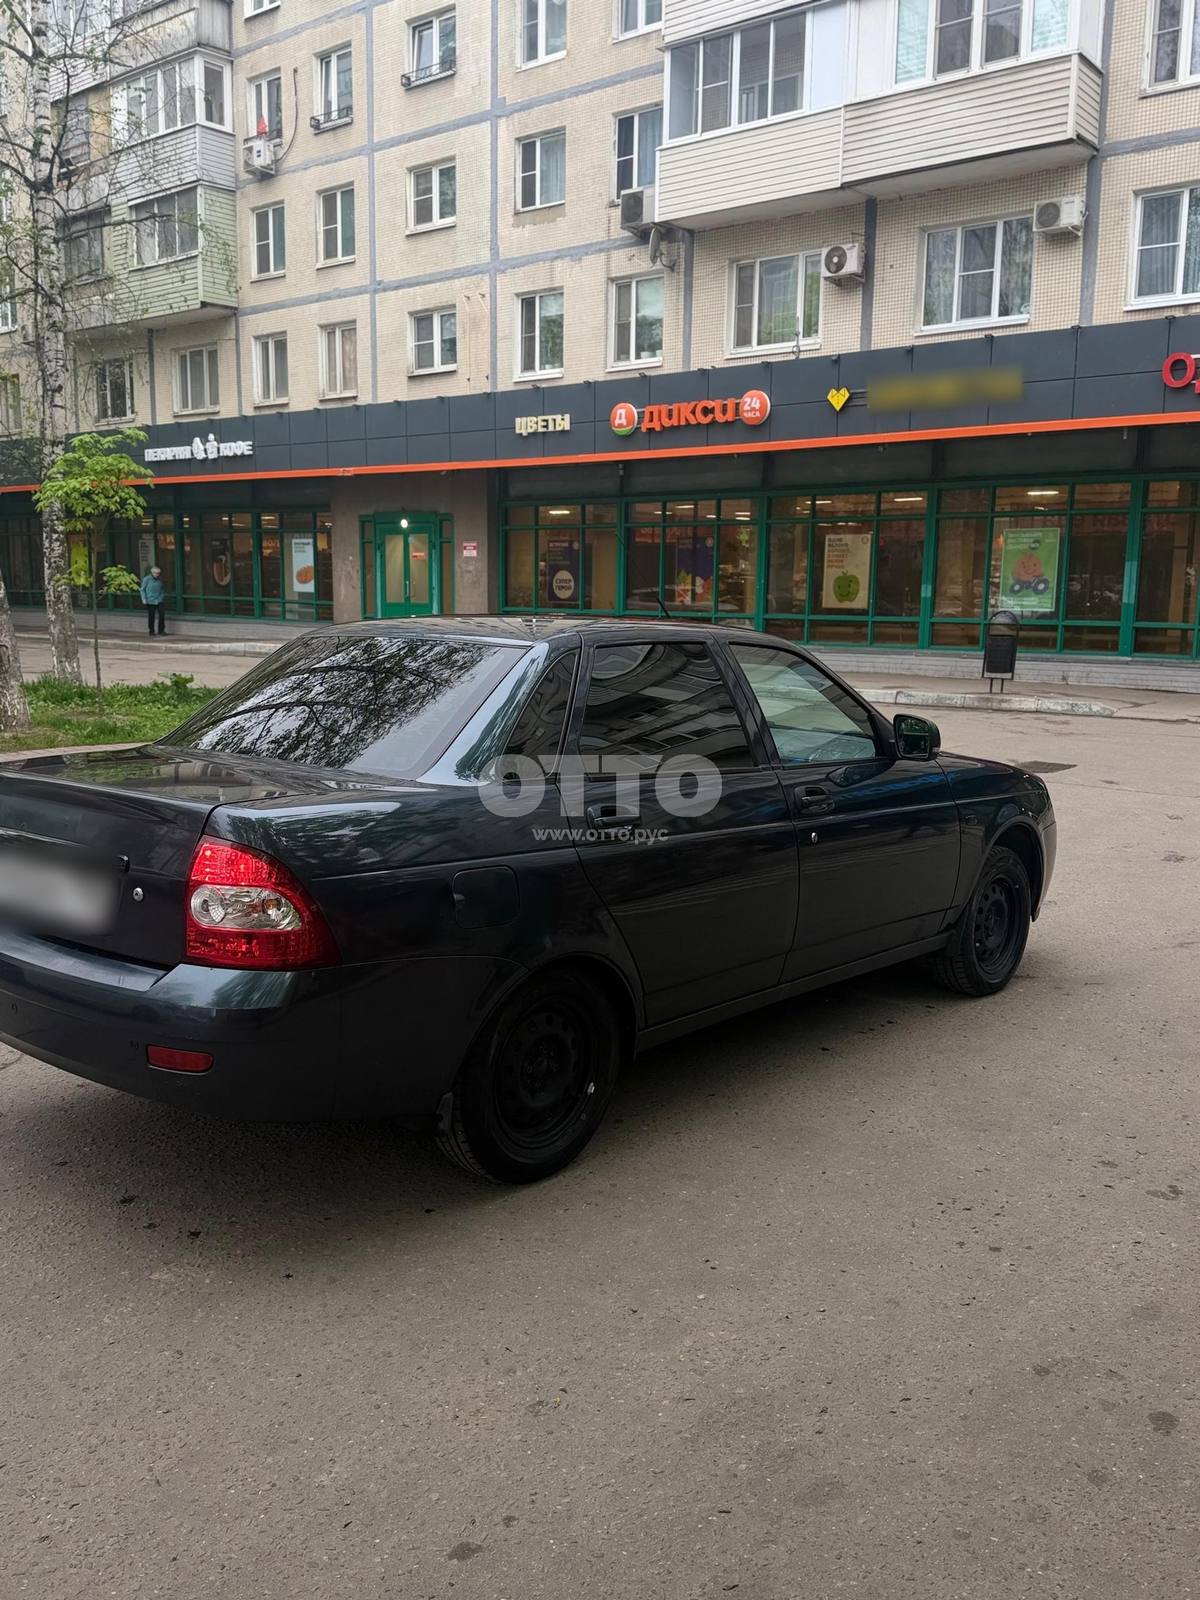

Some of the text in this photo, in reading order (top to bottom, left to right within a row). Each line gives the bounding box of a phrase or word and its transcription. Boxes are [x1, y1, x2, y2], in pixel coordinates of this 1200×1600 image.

[743, 397, 761, 411] 24
[614, 409, 628, 427] Д
[641, 398, 737, 433] ДИКСИ
[743, 410, 761, 418] ЧАСА
[515, 413, 571, 436] ЦВЕТЫ
[219, 441, 253, 457] КОФЕ
